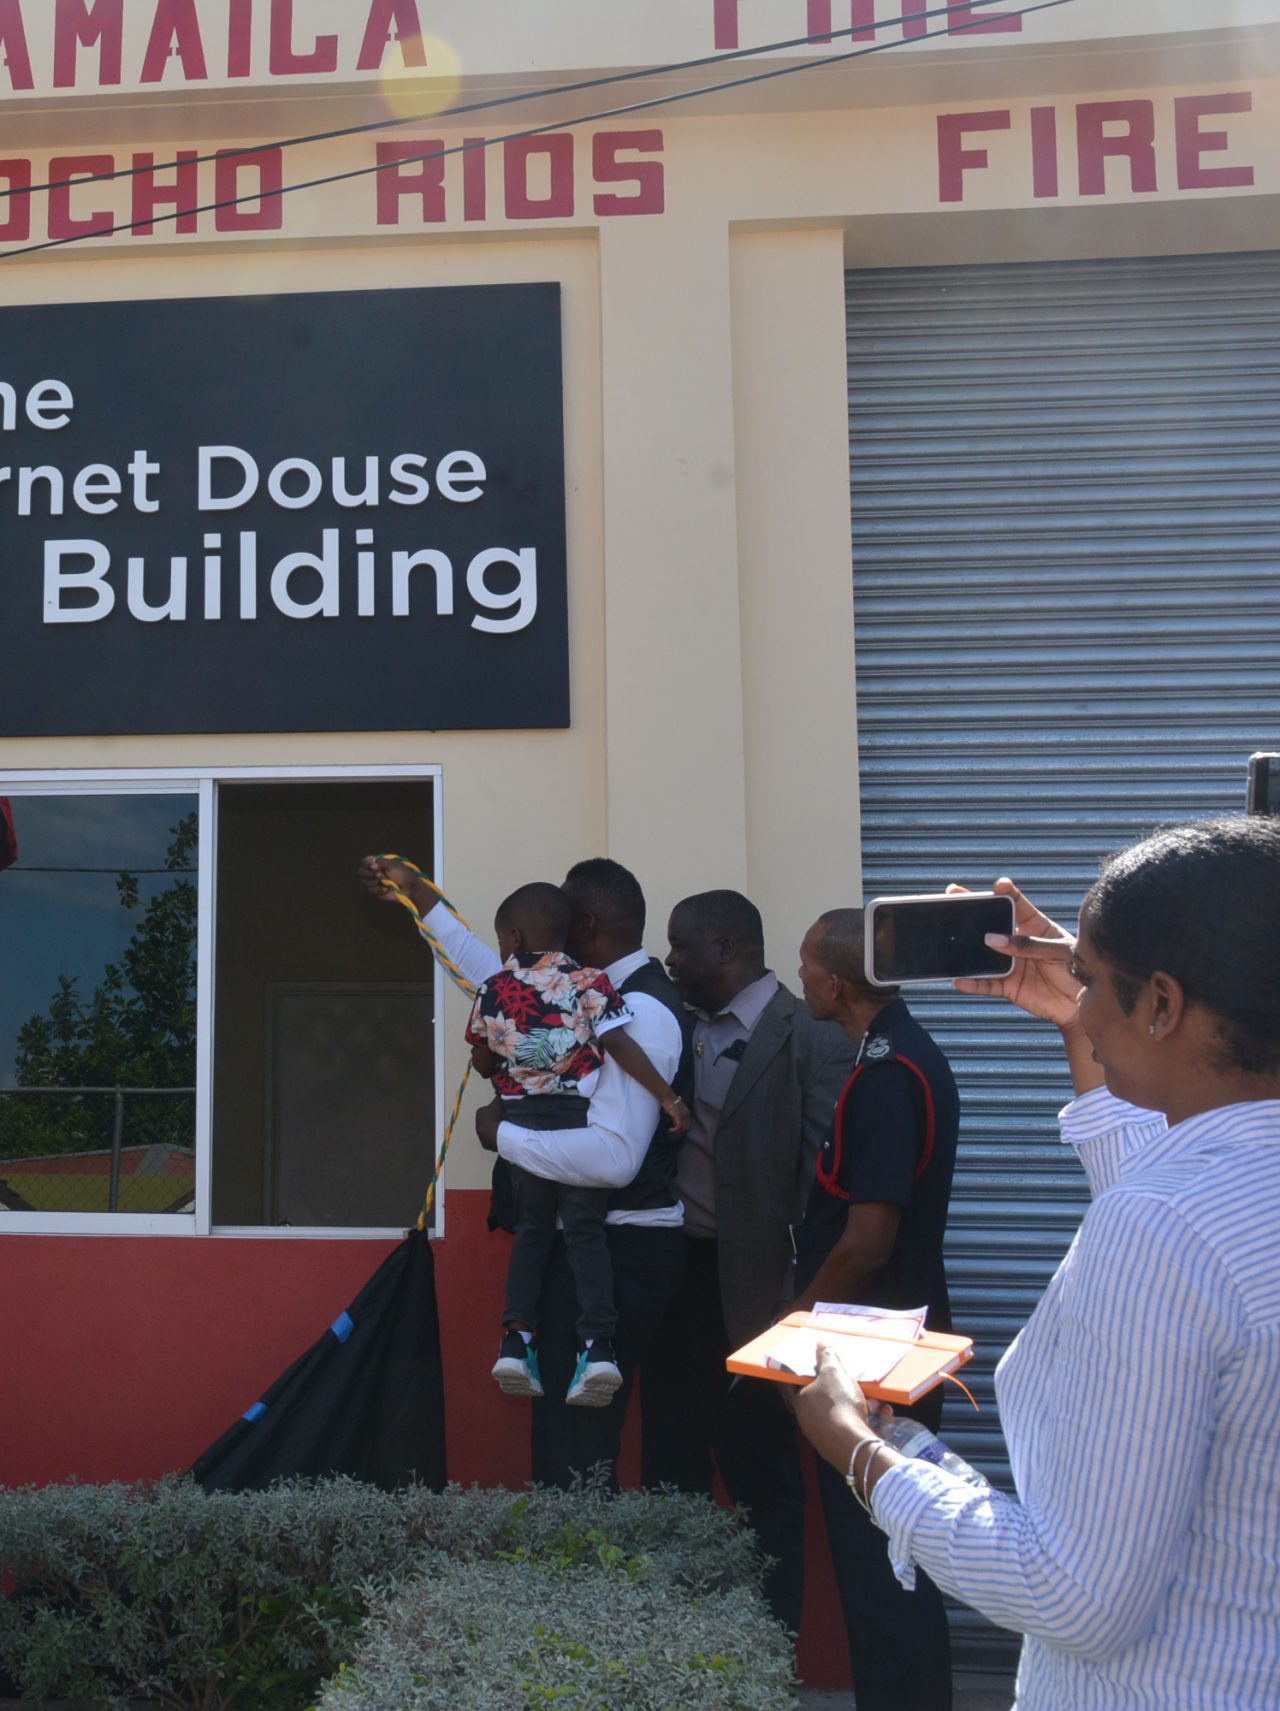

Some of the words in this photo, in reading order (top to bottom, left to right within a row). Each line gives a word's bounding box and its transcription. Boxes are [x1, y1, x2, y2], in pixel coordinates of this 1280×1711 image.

[376, 129, 665, 226] RIOS
[937, 92, 1255, 203] FIRE
[198, 445, 487, 511] Douse
[43, 528, 538, 634] Building
